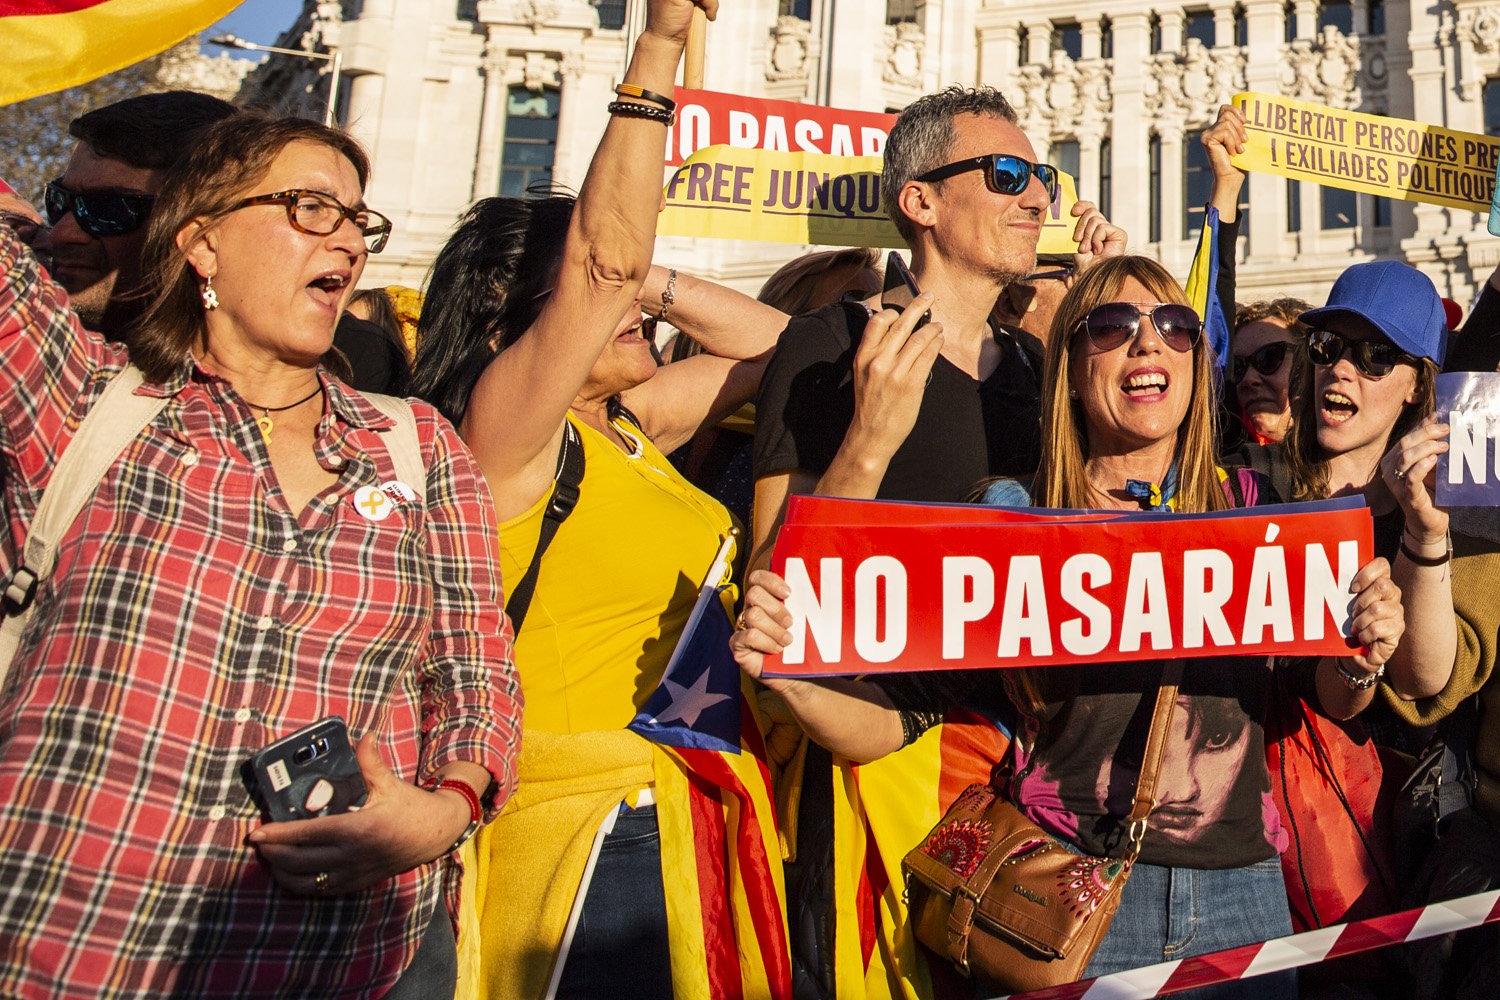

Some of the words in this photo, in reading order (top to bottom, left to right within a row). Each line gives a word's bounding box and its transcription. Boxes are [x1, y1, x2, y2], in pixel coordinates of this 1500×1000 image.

[1241, 99, 1348, 143] LLIBERTAT
[1355, 121, 1458, 163] PERSONES
[666, 163, 754, 206] FREE
[1270, 138, 1278, 163] I
[1286, 141, 1389, 184] EXILIADES
[781, 554, 908, 665] NO
[942, 522, 1360, 660] PASARÁN
